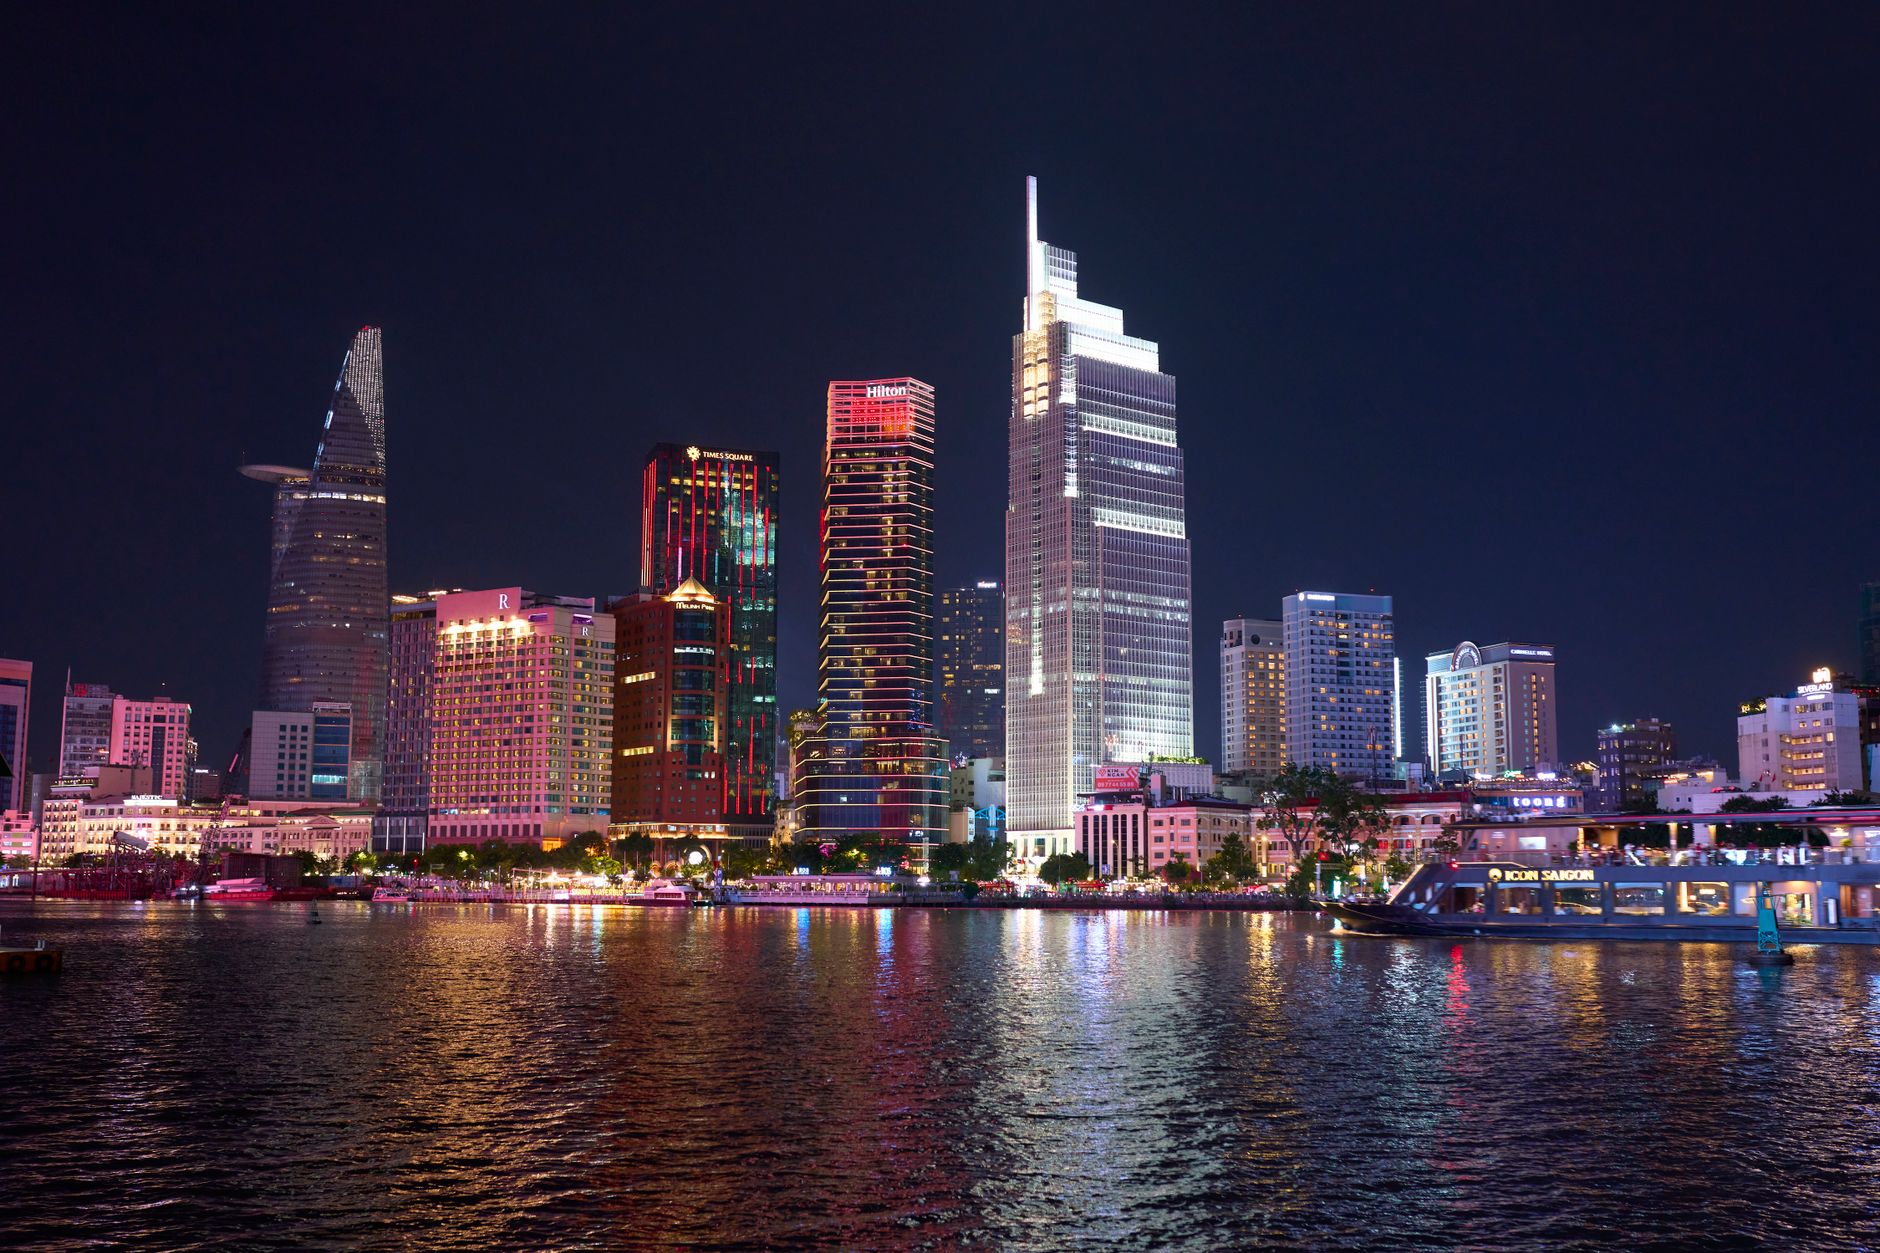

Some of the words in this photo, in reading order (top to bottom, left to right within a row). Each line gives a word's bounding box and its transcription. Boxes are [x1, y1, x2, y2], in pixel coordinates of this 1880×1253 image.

[867, 385, 906, 398] Hilton
[703, 451, 723, 459] TIMES
[725, 453, 753, 461] SQUARE
[499, 593, 510, 609] R
[582, 626, 588, 636] R
[1797, 682, 1833, 694] SILVERLAND
[1513, 796, 1566, 808] toong
[1504, 870, 1538, 881] ICON
[1541, 870, 1595, 881] SAIGON
